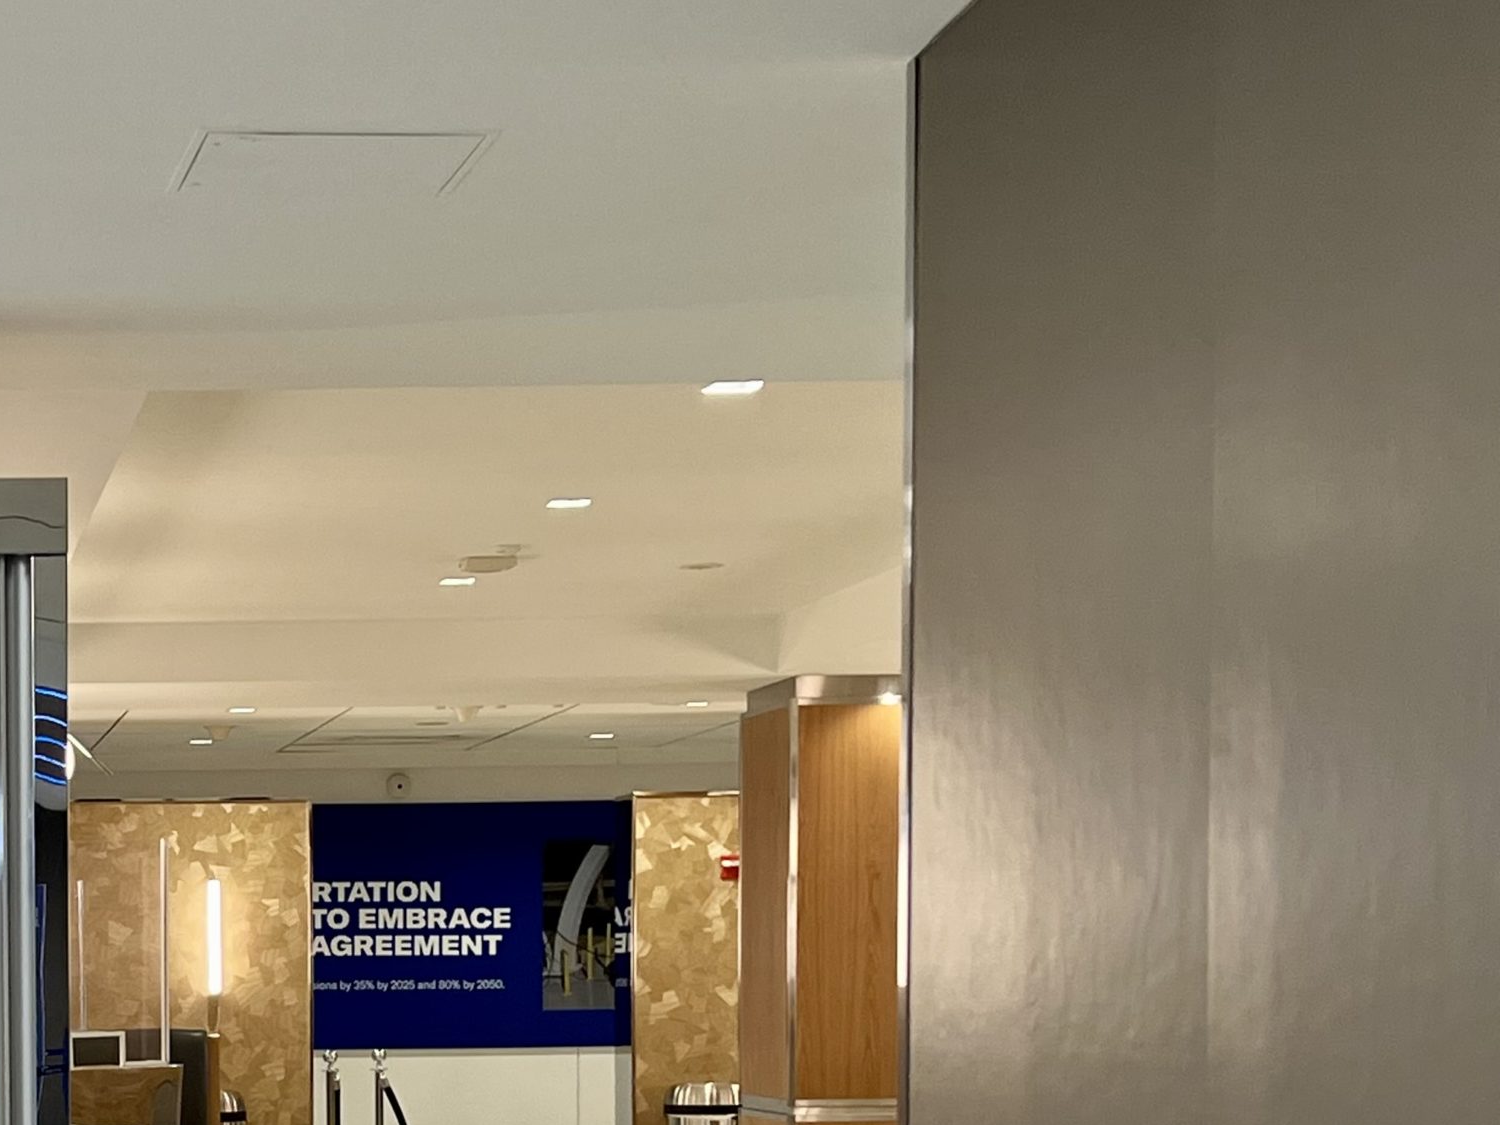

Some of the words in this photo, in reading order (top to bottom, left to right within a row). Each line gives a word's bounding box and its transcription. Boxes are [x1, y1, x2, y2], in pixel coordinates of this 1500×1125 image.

[312, 908, 350, 928] TO
[358, 907, 511, 929] EMBRACE
[311, 934, 502, 956] AGREEMENT
[339, 981, 351, 992] by
[353, 980, 375, 990] 35%
[377, 981, 389, 992] by
[391, 980, 415, 990] 2025
[417, 980, 436, 990] and
[463, 980, 475, 991] by
